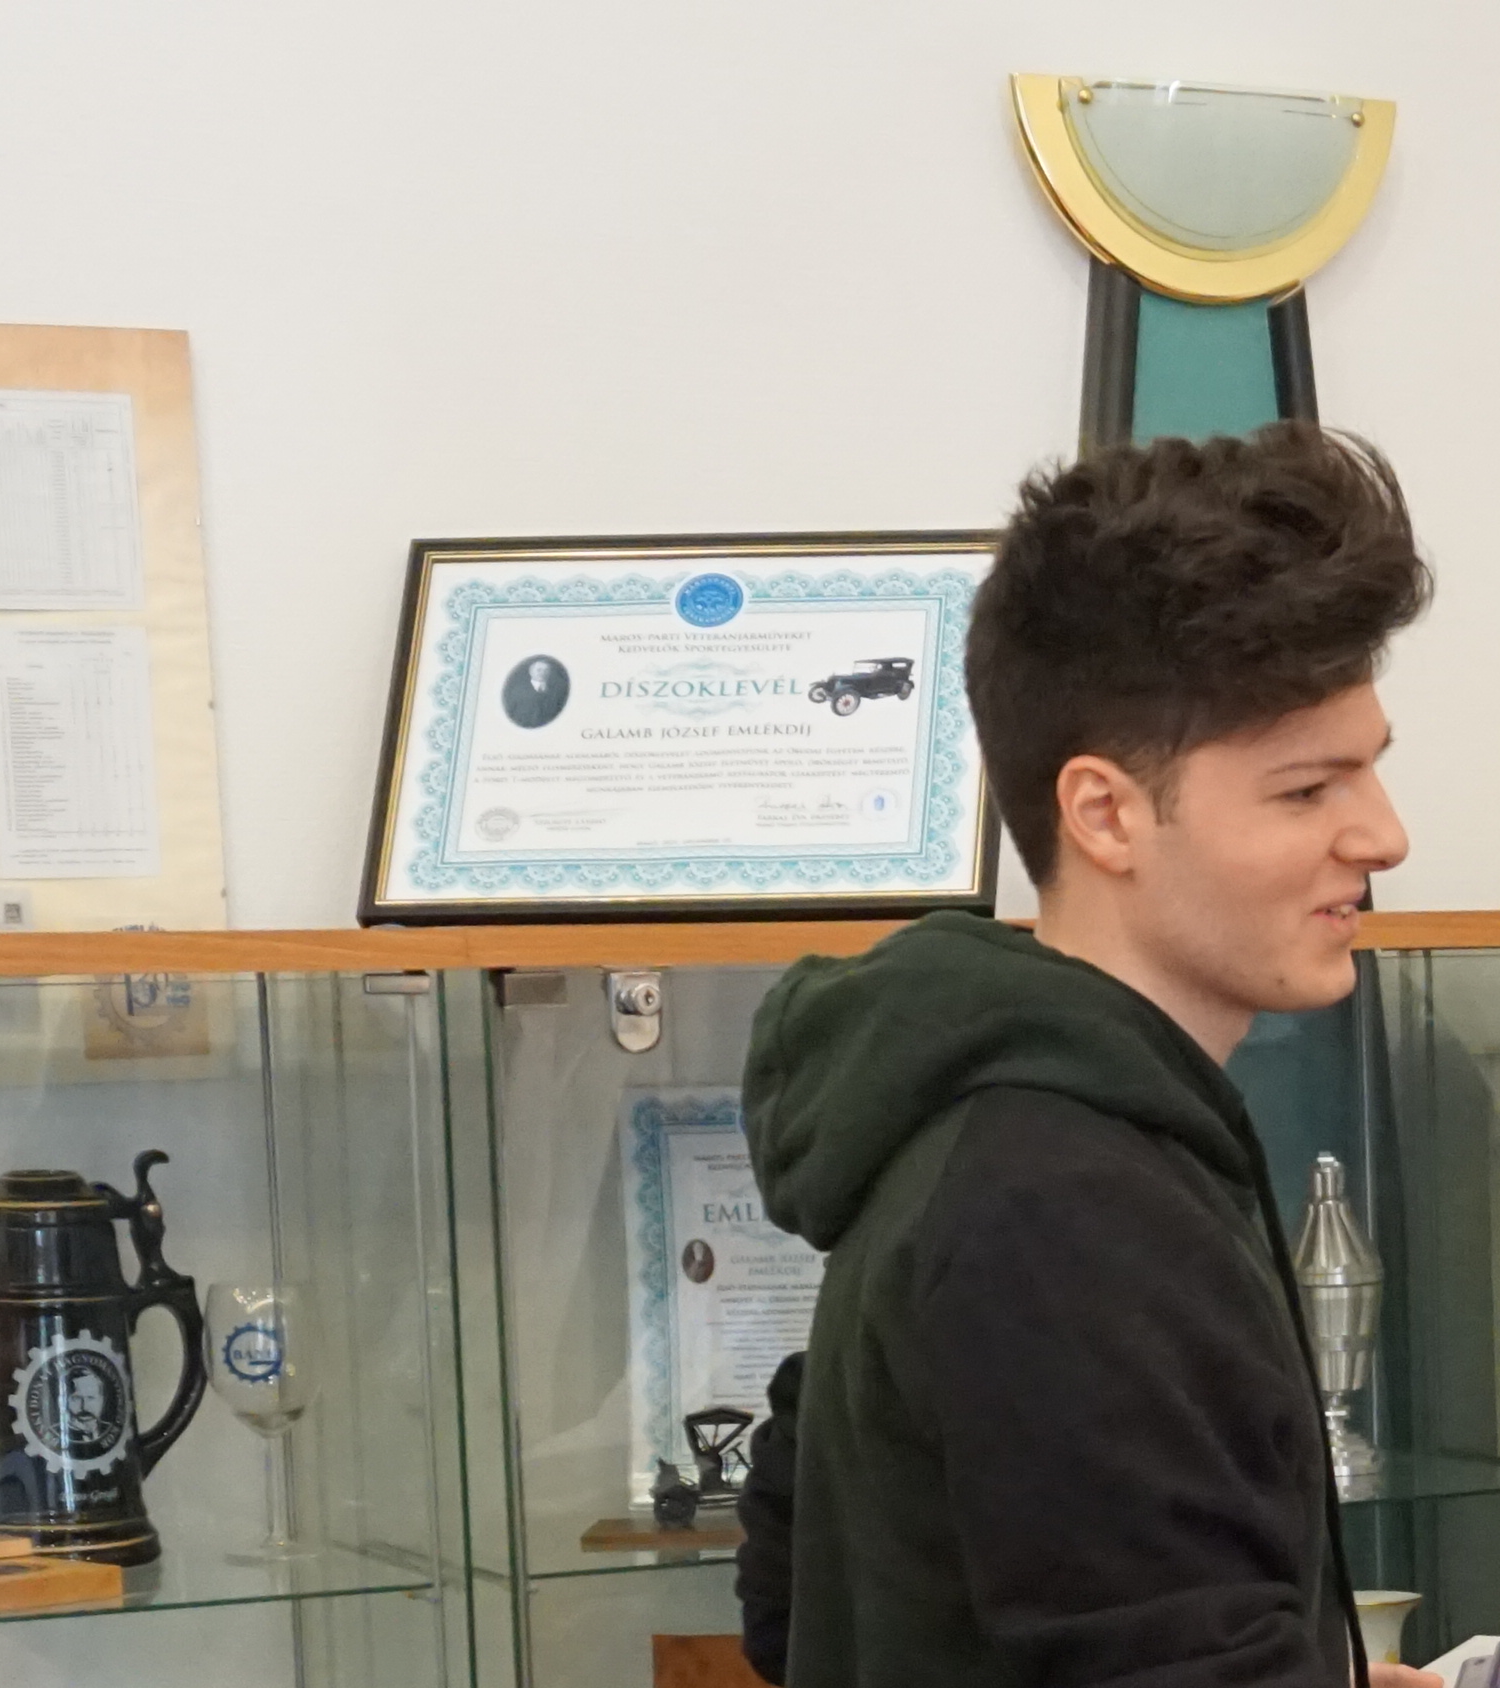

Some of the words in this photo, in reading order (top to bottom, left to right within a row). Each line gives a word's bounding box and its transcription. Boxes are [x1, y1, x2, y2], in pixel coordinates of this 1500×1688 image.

[599, 675, 803, 699] DÍSZOKLEVÉL
[581, 727, 653, 740] GALAMB
[660, 724, 719, 739] JÓZSEF
[728, 722, 811, 736] EMLÉKDÍJ
